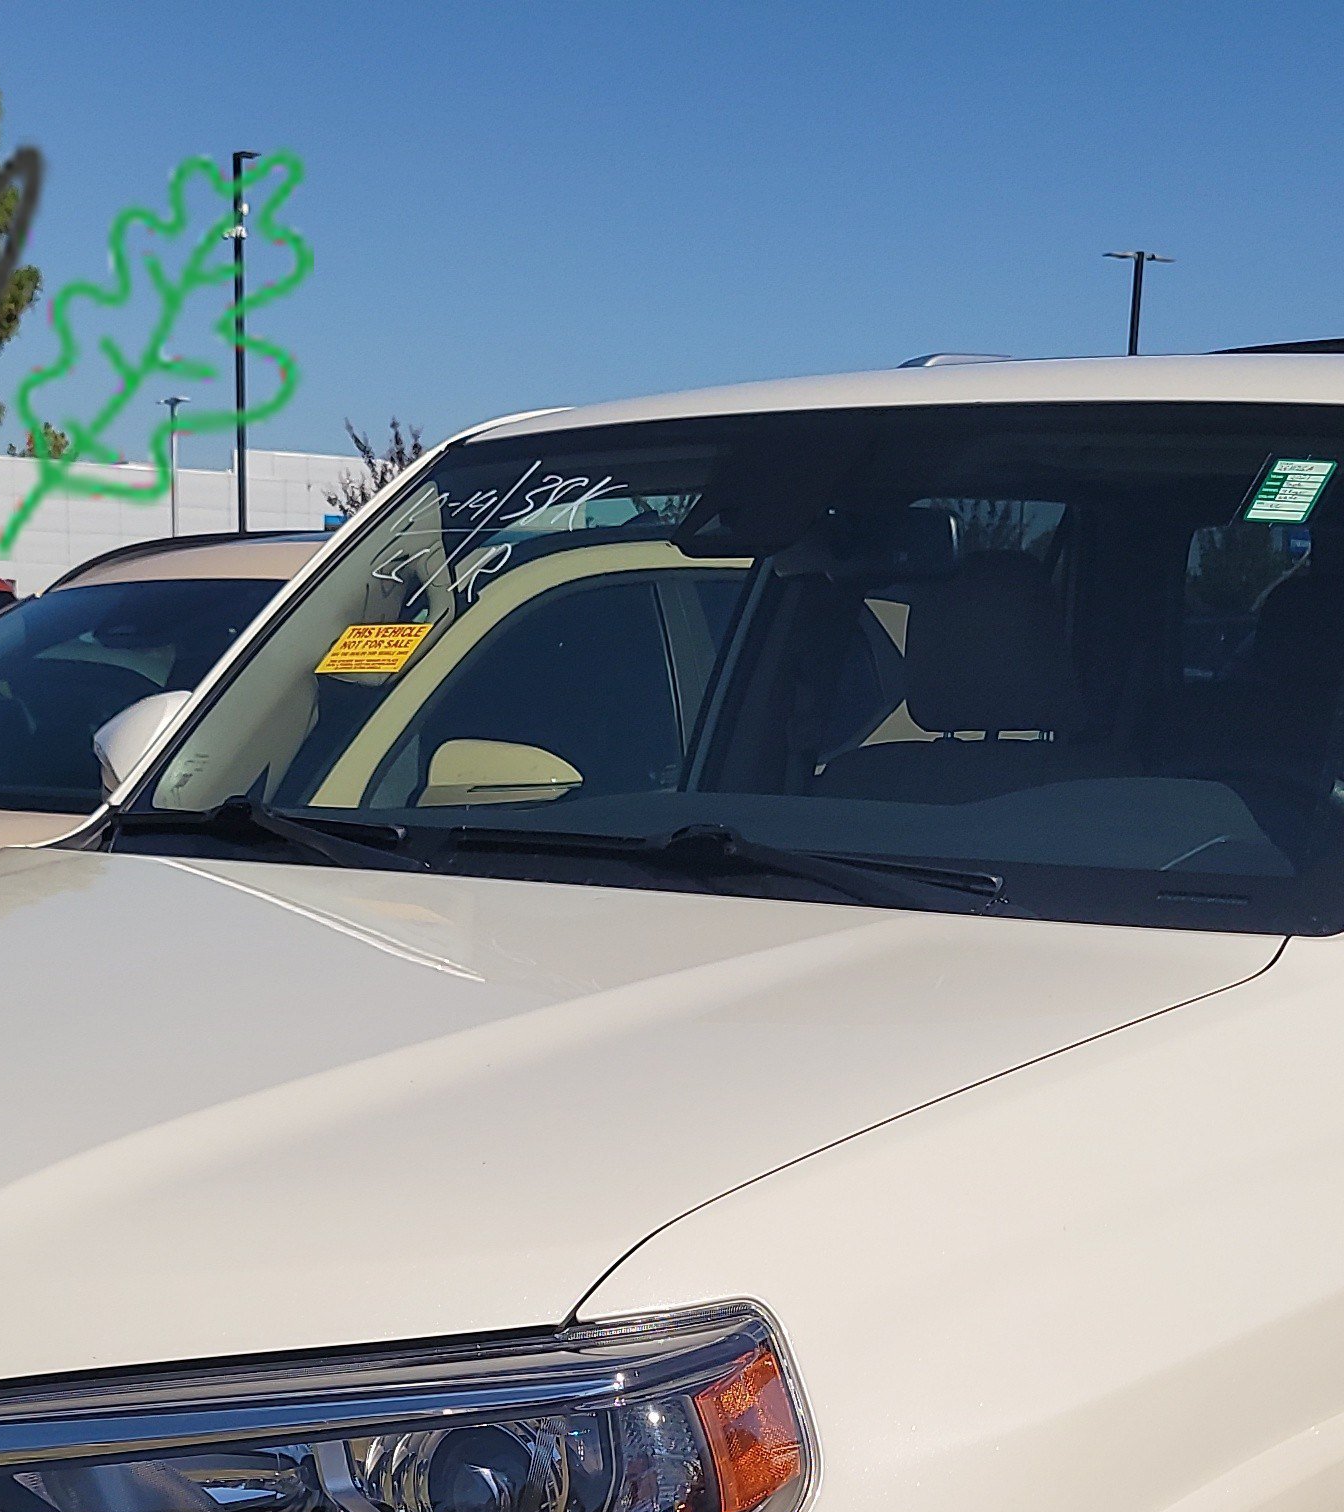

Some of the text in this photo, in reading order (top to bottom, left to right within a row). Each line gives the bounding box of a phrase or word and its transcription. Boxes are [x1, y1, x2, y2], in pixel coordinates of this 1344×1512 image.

[347, 626, 426, 639] THIS VEHICLE
[339, 639, 413, 650] NOT FOR SALE
